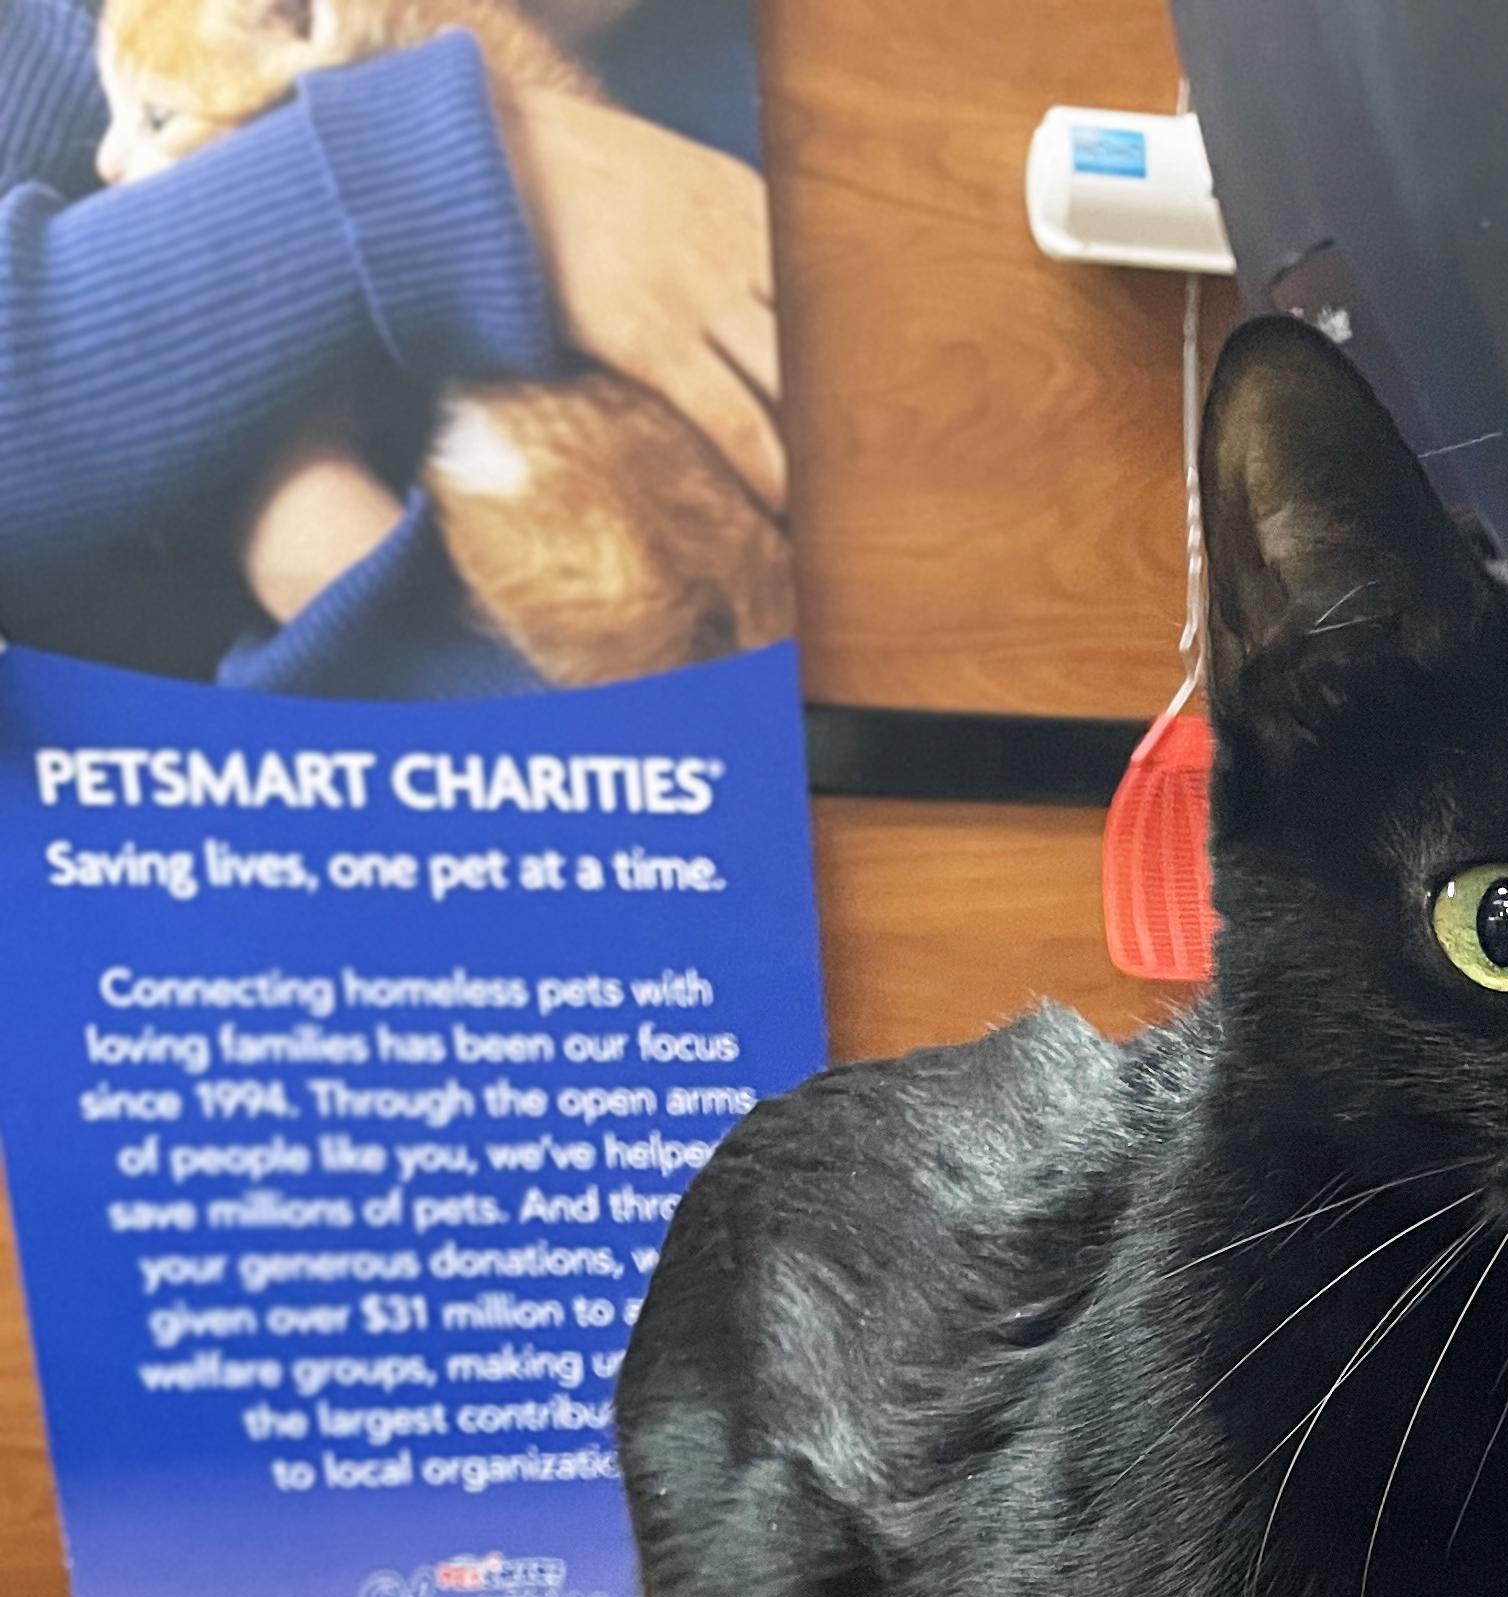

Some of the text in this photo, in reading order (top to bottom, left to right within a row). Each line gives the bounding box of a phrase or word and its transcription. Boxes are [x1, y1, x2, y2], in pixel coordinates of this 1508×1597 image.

[36, 748, 376, 808] PETSMART
[46, 837, 727, 901] Saving lives, one pet at a time.
[99, 965, 714, 1018] Connecting homeless pets with
[86, 1020, 741, 1075] loving families has been our focus
[80, 1077, 757, 1128] since 1994. Through the open arms
[117, 1133, 160, 1177] of
[170, 1135, 310, 1184] people
[319, 1134, 387, 1174] like
[395, 1143, 478, 1182] you,
[485, 1134, 597, 1173] we've
[107, 1183, 683, 1236] save millions of pets. And thro
[138, 1255, 228, 1295] your
[238, 1250, 421, 1293] generous
[429, 1239, 624, 1281] donations,
[149, 1299, 259, 1348] given
[266, 1304, 351, 1336] over
[361, 1293, 428, 1335] $31
[442, 1291, 565, 1331] million
[572, 1293, 616, 1328] to
[138, 1349, 285, 1391] welfare
[292, 1354, 438, 1397] groups,
[446, 1342, 584, 1389] making
[243, 1394, 618, 1446] the largest contribu
[271, 1444, 626, 1493] to local organizatio
